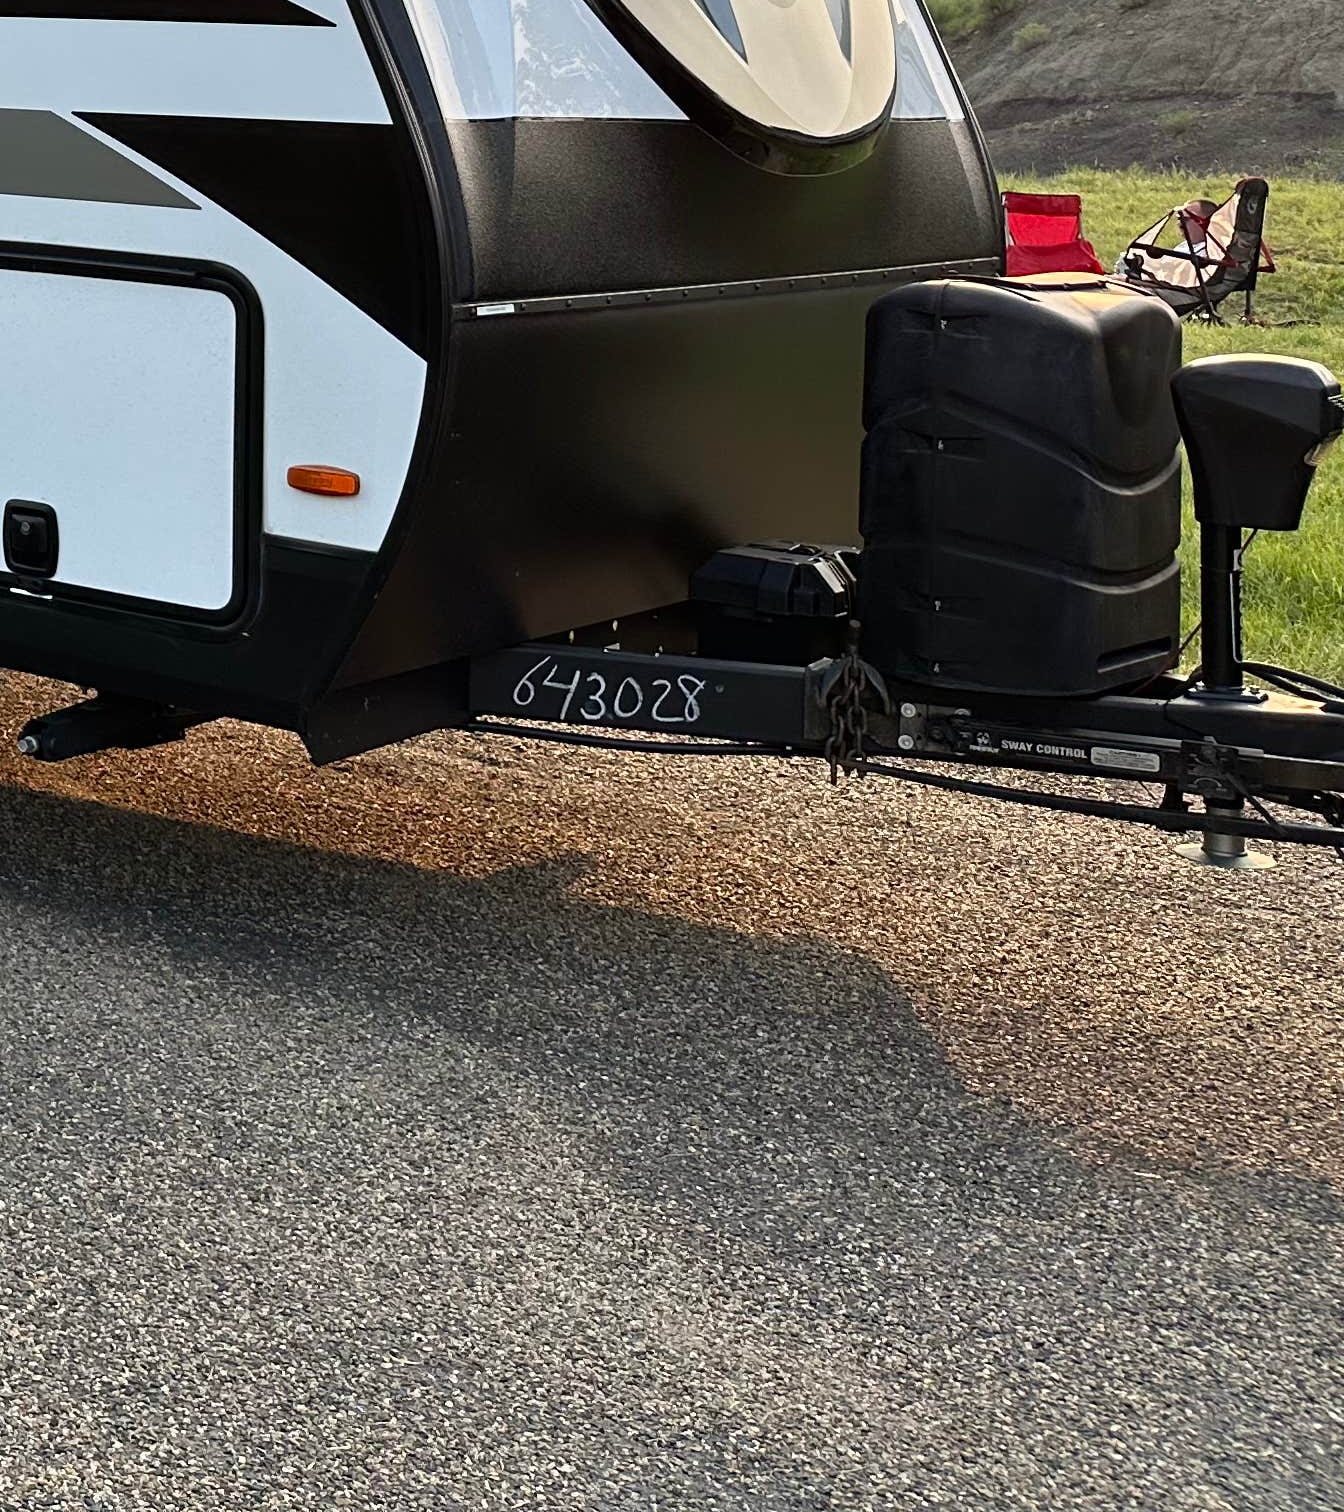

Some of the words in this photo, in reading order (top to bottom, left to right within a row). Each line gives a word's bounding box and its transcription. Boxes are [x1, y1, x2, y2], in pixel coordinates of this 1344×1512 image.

[513, 655, 706, 721] 643028
[1001, 739, 1033, 752] SWAY
[1036, 744, 1088, 759] CONTROL
